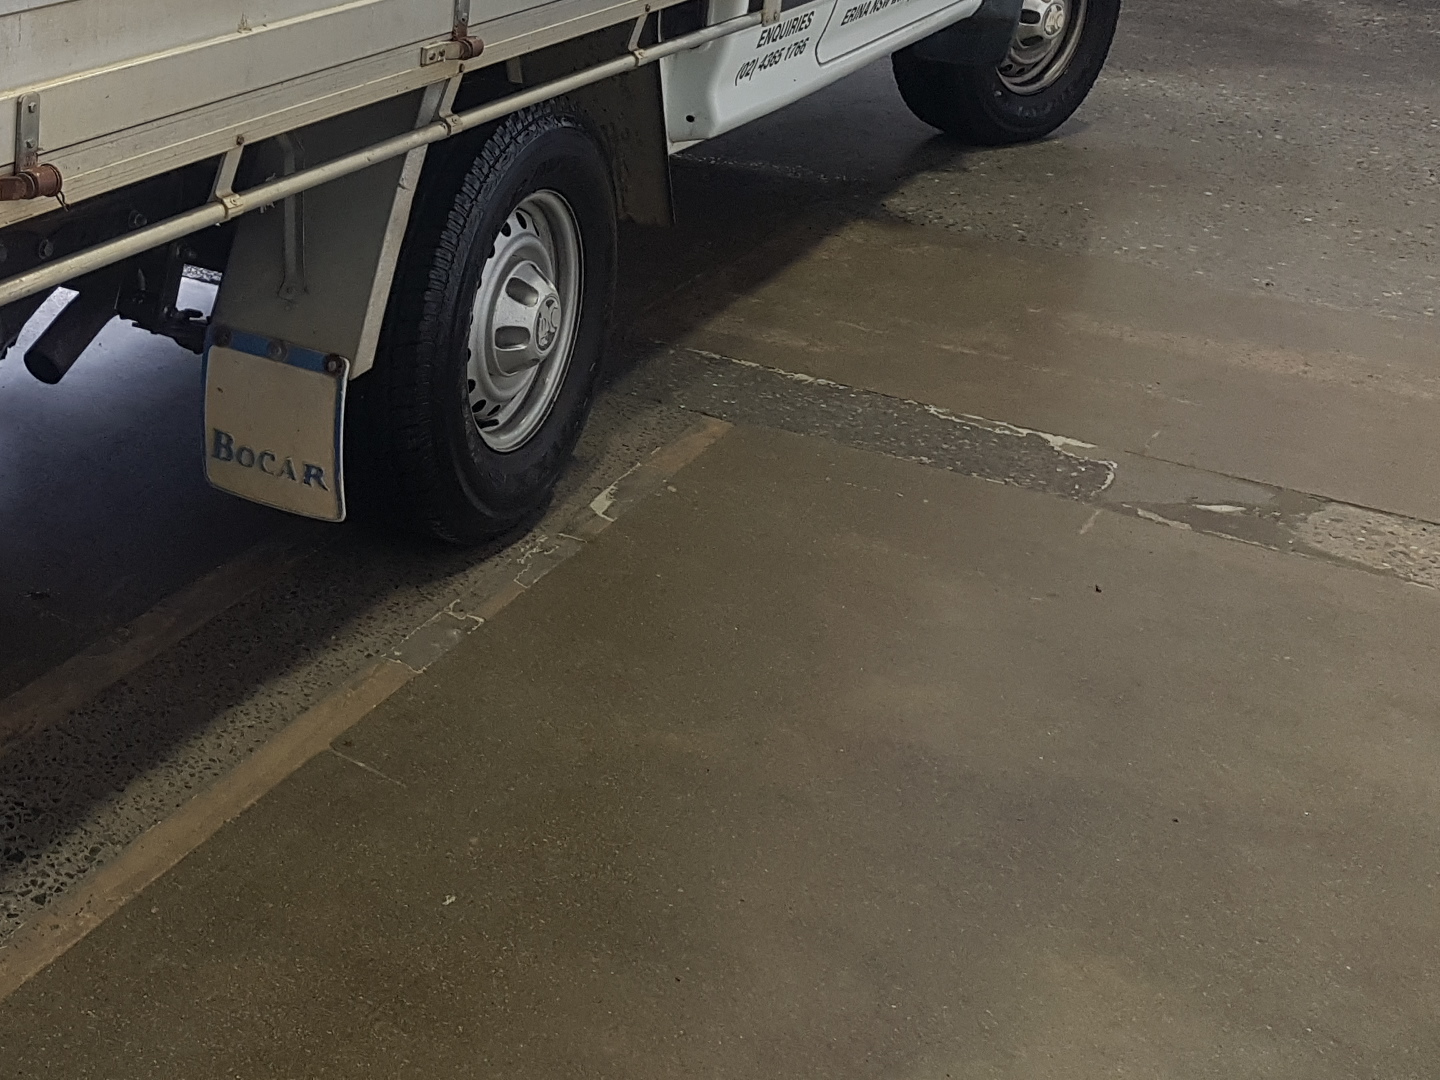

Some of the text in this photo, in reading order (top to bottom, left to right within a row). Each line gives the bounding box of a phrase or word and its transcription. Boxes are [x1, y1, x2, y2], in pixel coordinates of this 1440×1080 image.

[840, 0, 872, 27] ERINA
[755, 10, 815, 49] ENQUIRIES
[734, 56, 760, 87] (02)
